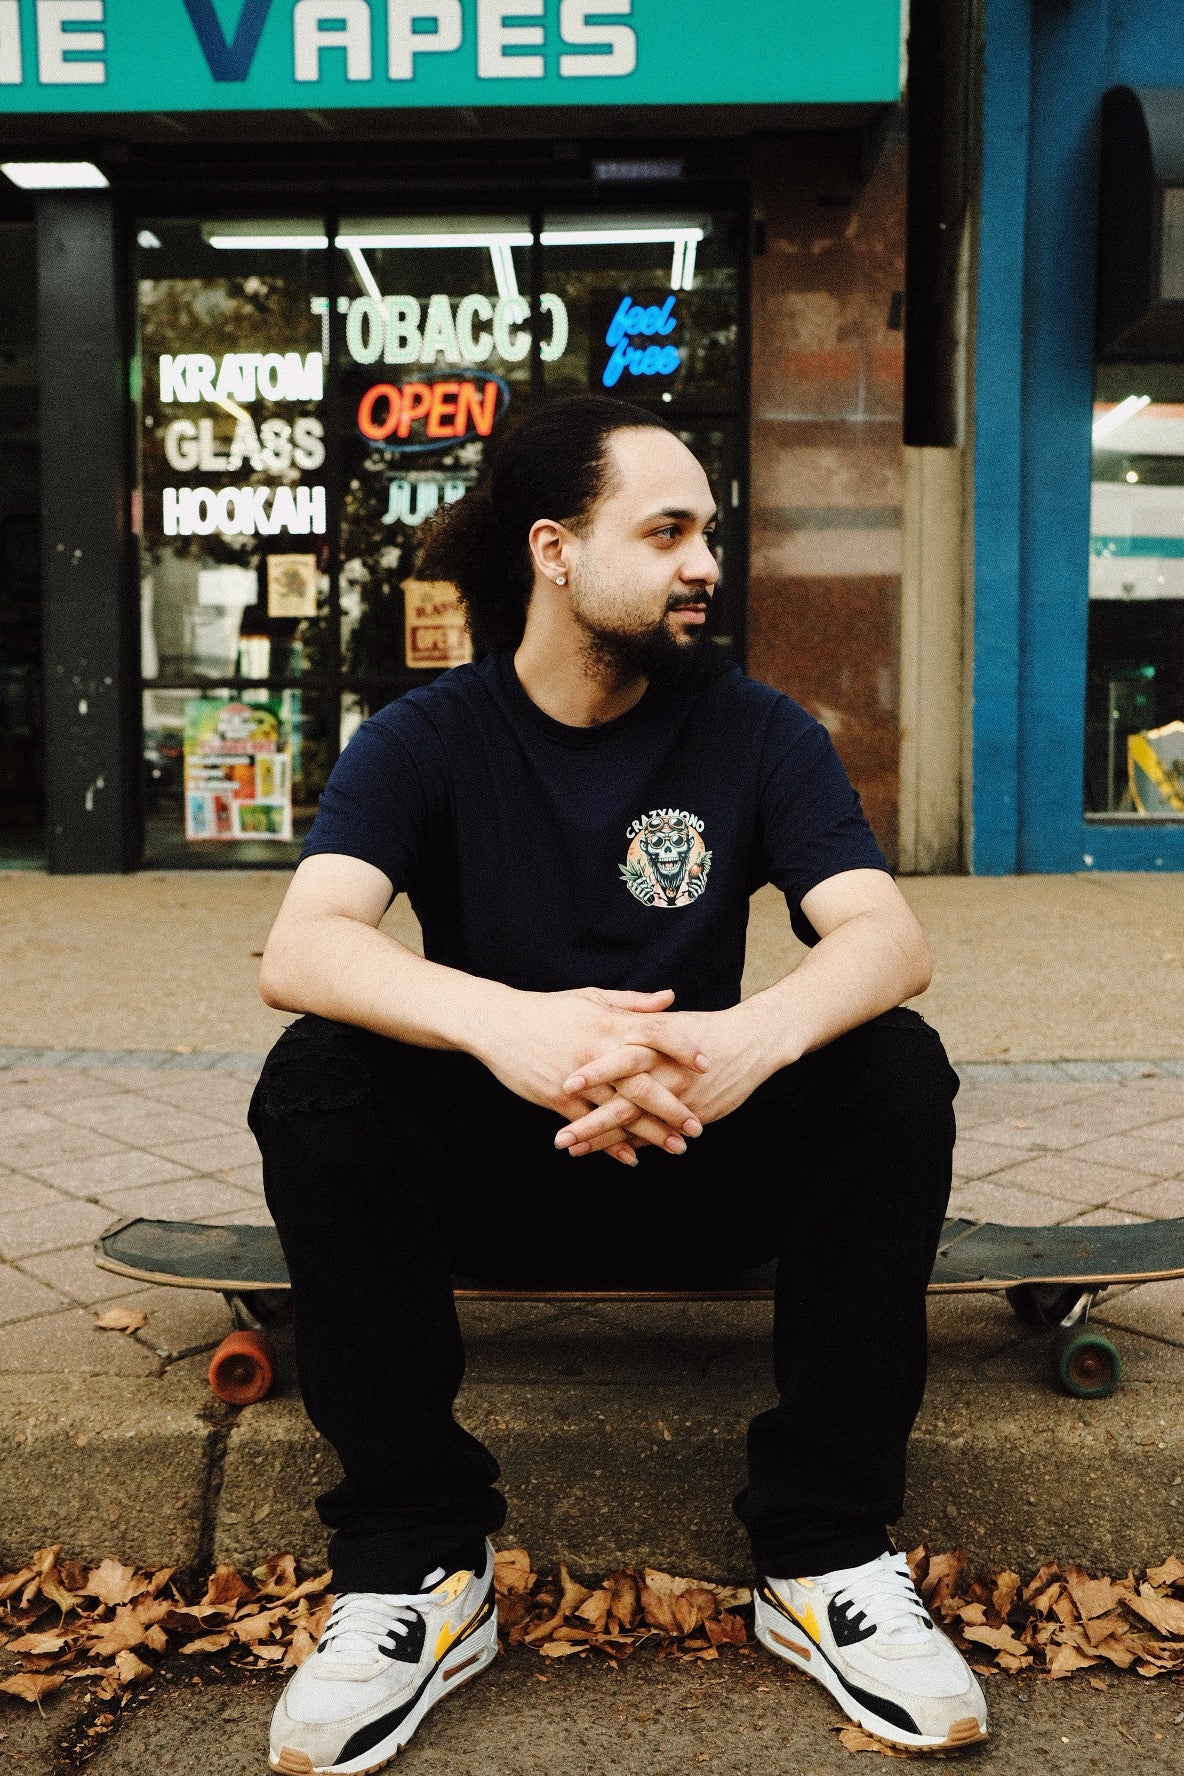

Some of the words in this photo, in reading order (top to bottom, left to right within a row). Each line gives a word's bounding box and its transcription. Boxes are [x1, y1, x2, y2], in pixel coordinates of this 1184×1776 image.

[181, 0, 638, 83] VAPES
[159, 352, 323, 402] KRATOM
[357, 380, 499, 440] OPEN
[164, 417, 326, 472] GLASS
[162, 486, 327, 536] HOOKAH
